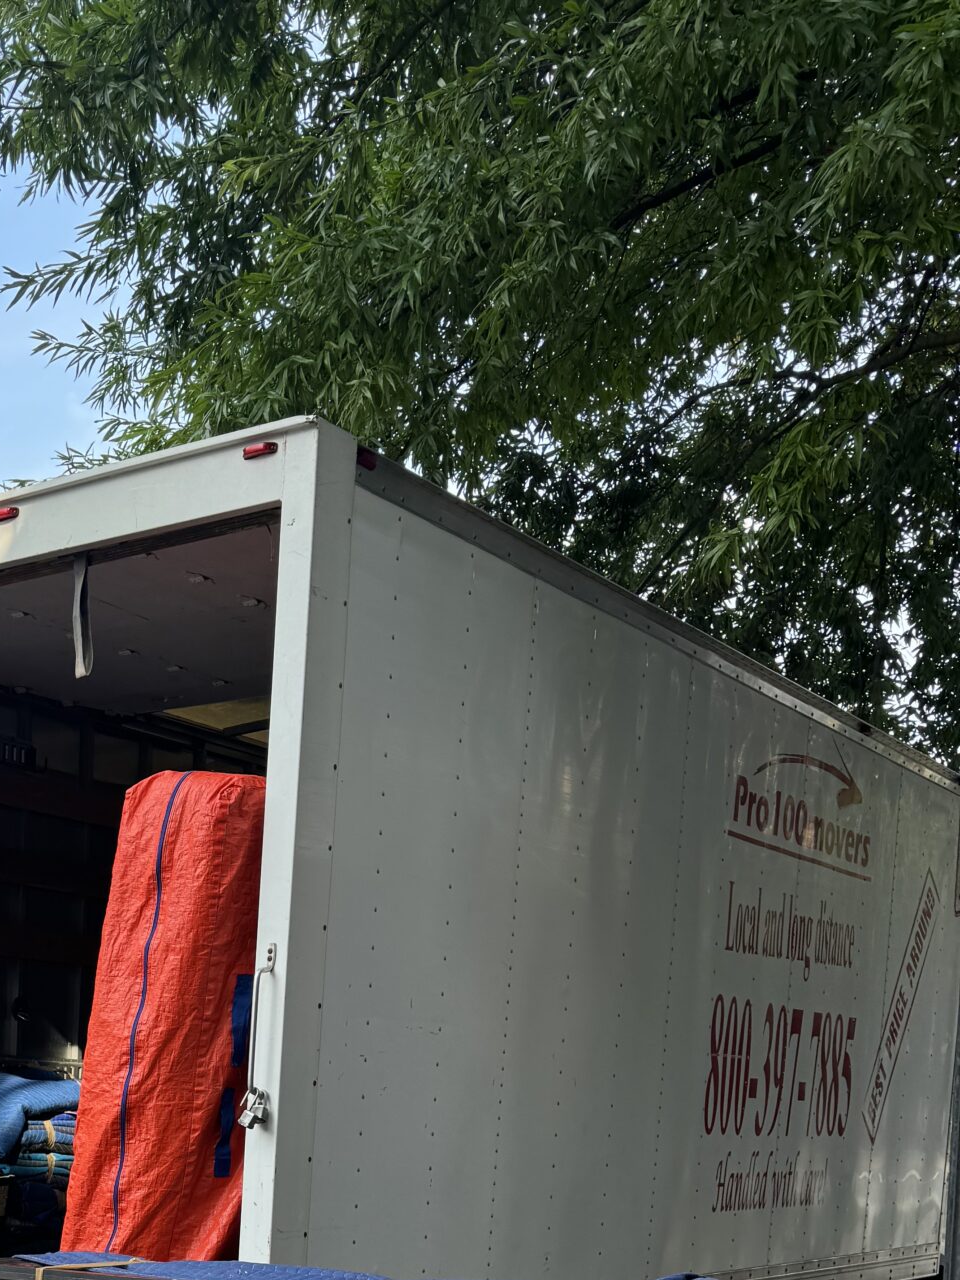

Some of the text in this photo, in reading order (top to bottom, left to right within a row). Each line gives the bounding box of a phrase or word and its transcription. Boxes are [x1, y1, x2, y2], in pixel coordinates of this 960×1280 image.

[725, 881, 855, 981] Local and long distance
[704, 993, 856, 1136] 800-397-7885
[868, 887, 935, 1128] BEST PRICE AROUND
[712, 1150, 773, 1212] Handled
[771, 1150, 801, 1208] with
